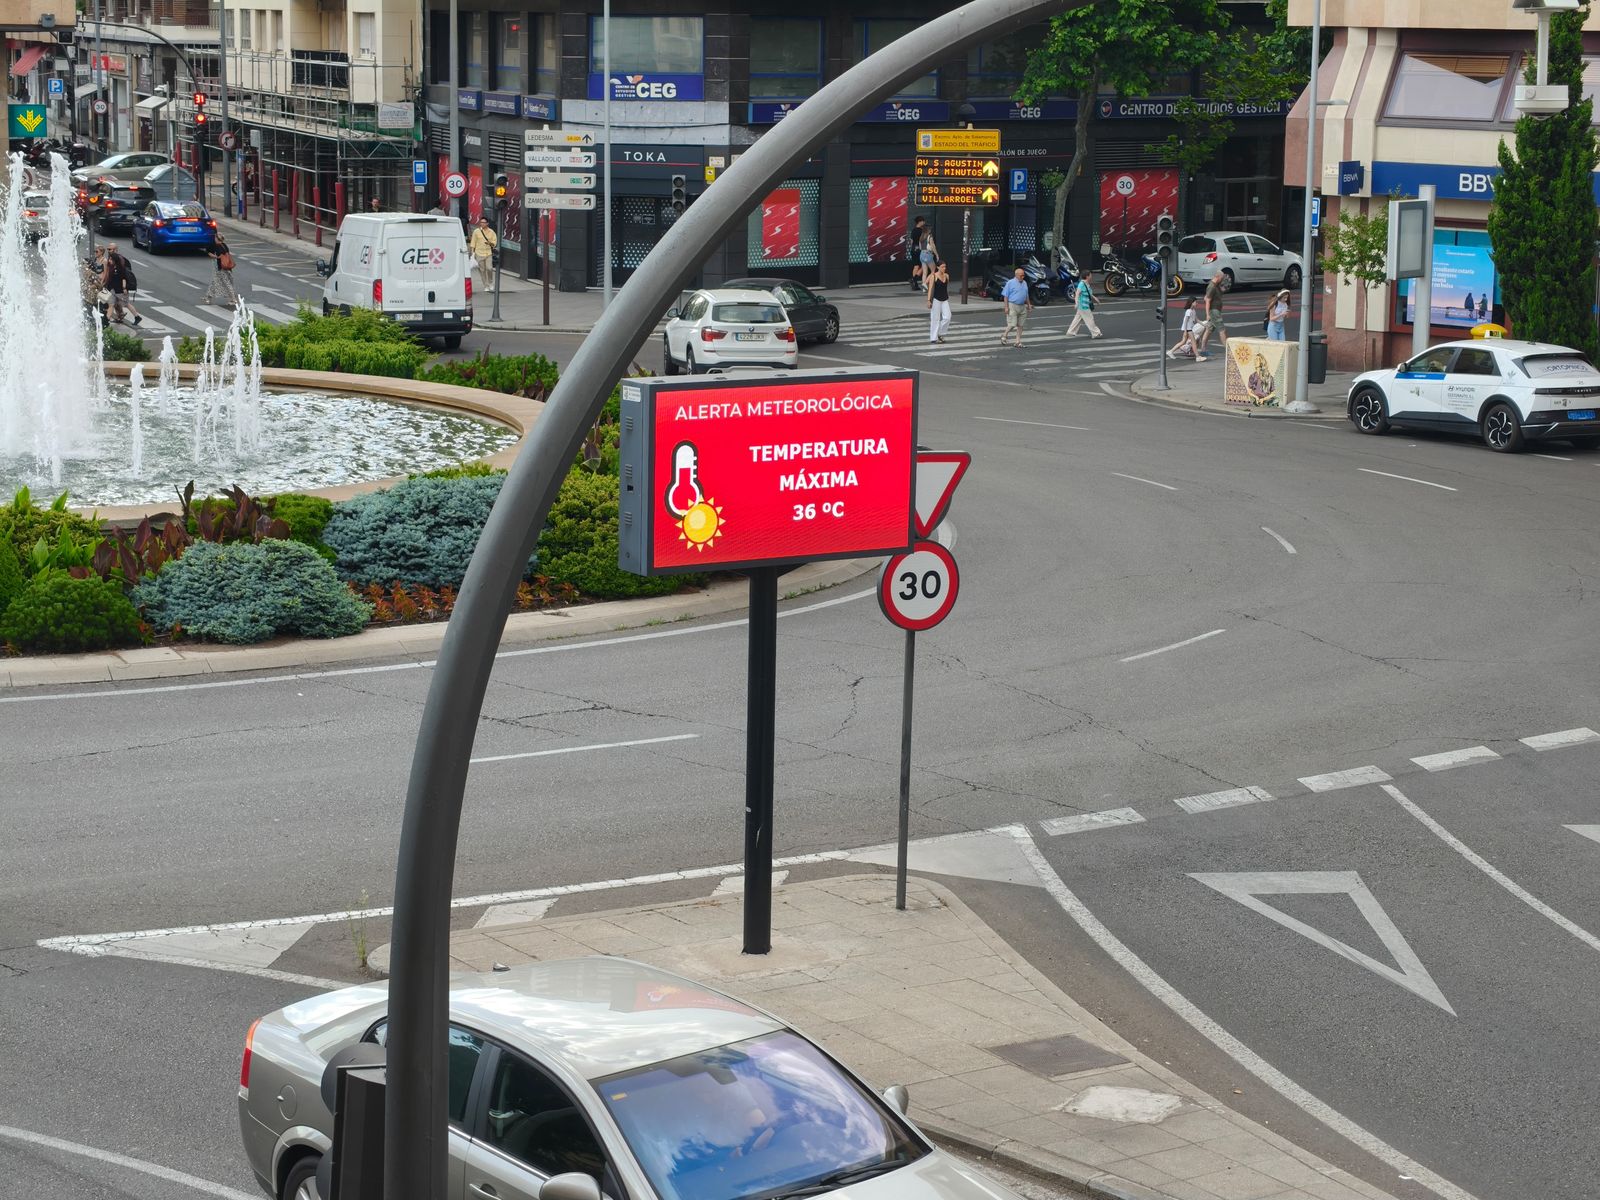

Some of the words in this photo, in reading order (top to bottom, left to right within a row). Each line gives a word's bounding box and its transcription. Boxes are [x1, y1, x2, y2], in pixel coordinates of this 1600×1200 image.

[636, 82, 677, 98] CEG
[195, 94, 204, 103] 31
[898, 108, 920, 120] CEG
[1020, 107, 1041, 118] CEG
[1120, 104, 1163, 115] CENTRO
[1166, 104, 1179, 115] DE
[624, 152, 666, 162] TOKA
[449, 180, 462, 188] 30
[1014, 170, 1024, 190] P
[675, 402, 742, 421] ALERTA
[748, 392, 892, 416] METEOROLÓGICA
[749, 438, 888, 462] TEMPERATURA
[780, 469, 858, 492] MÁXIMA
[792, 504, 816, 521] 36
[899, 570, 941, 600] 30
